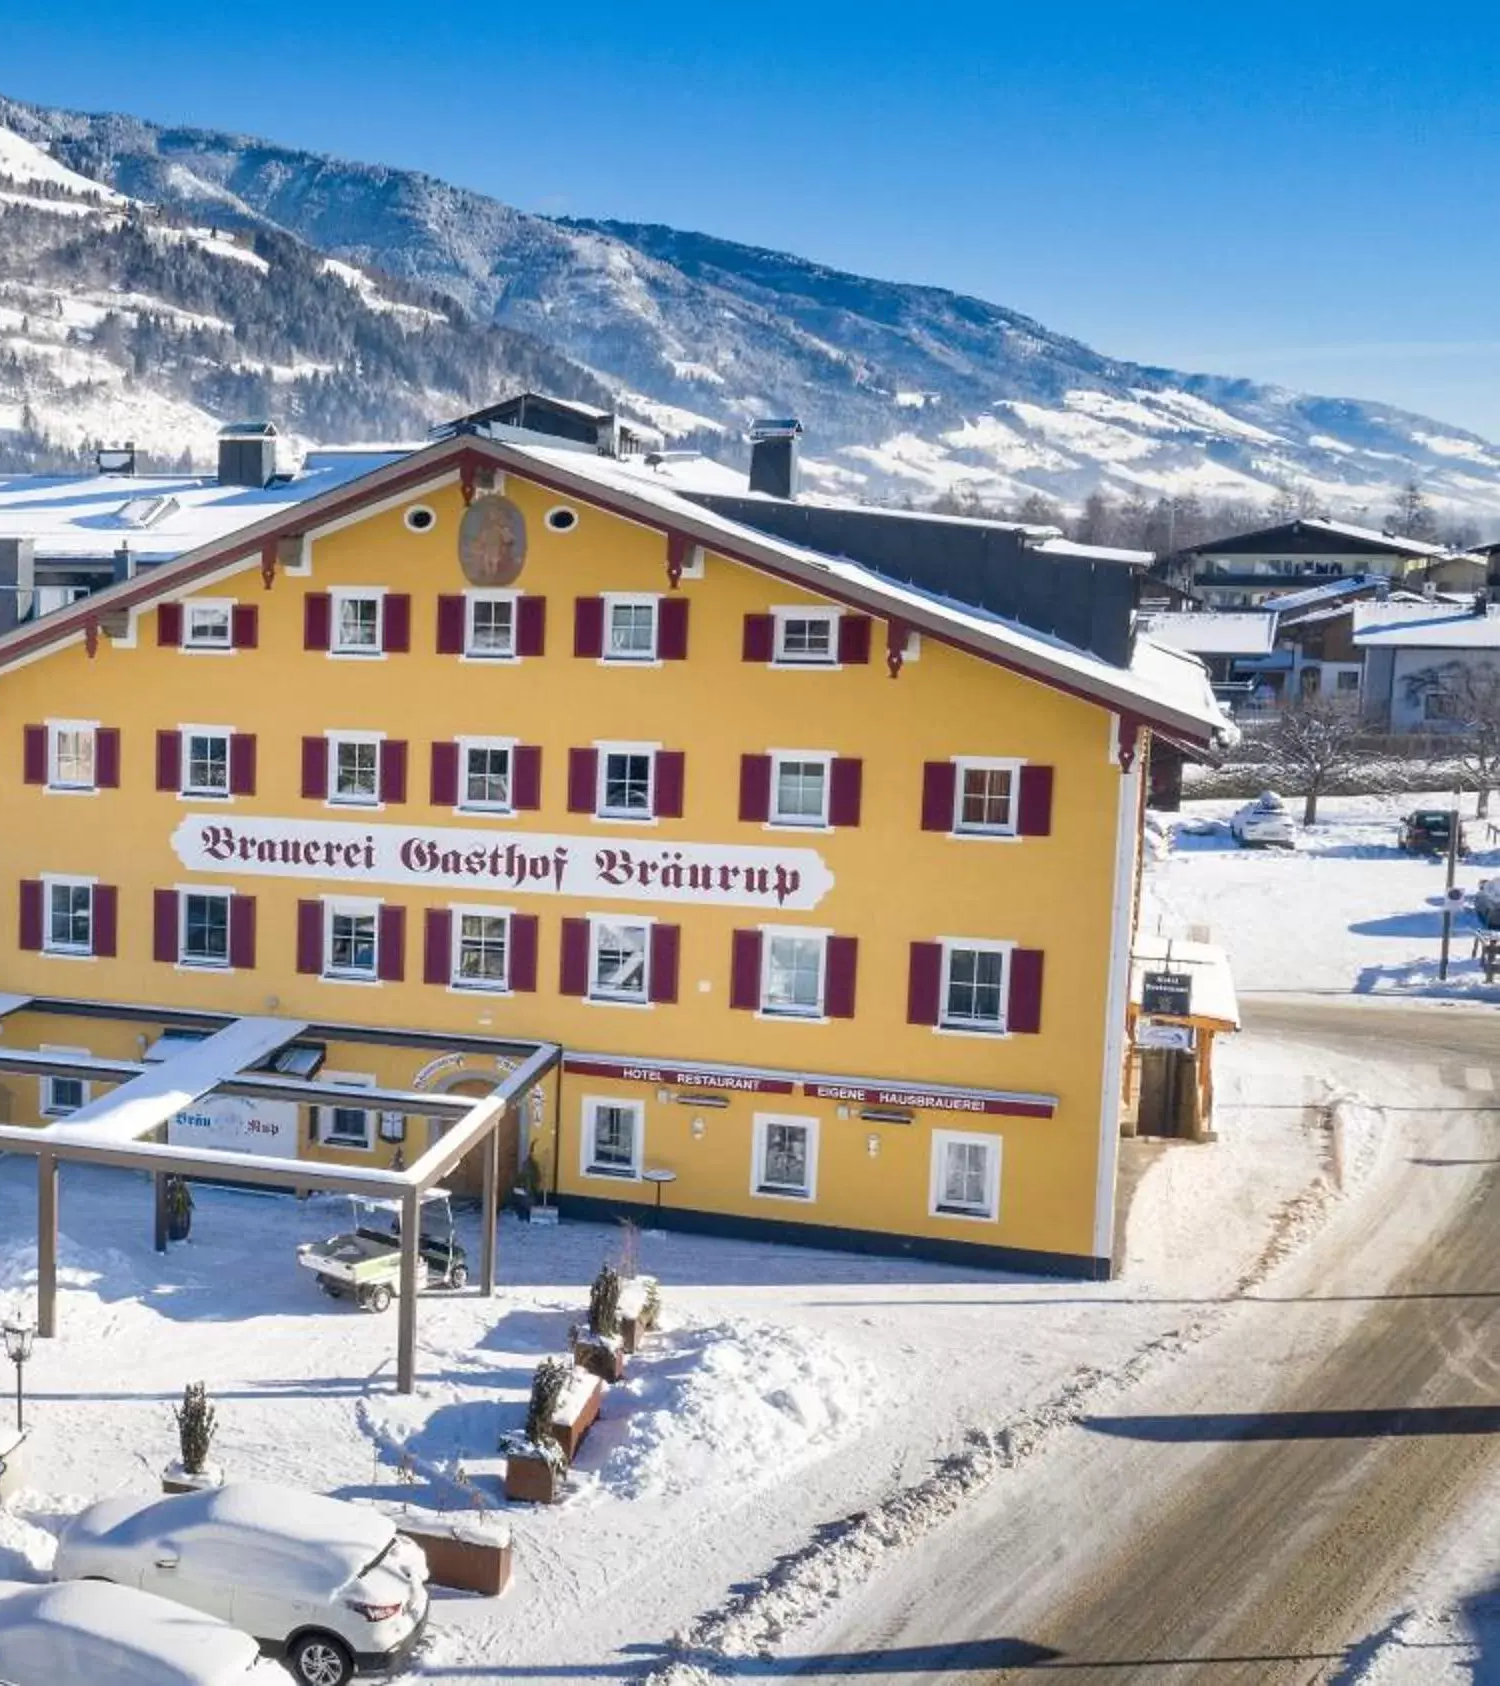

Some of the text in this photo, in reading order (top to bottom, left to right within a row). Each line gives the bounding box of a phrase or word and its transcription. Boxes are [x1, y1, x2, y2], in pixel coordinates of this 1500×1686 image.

[201, 825, 801, 906] Brauerei Gasthof Bräurup
[623, 1066, 761, 1092] HOTEL RESTAURANT
[817, 1086, 987, 1112] EIGENE HAUSBRAUEREI
